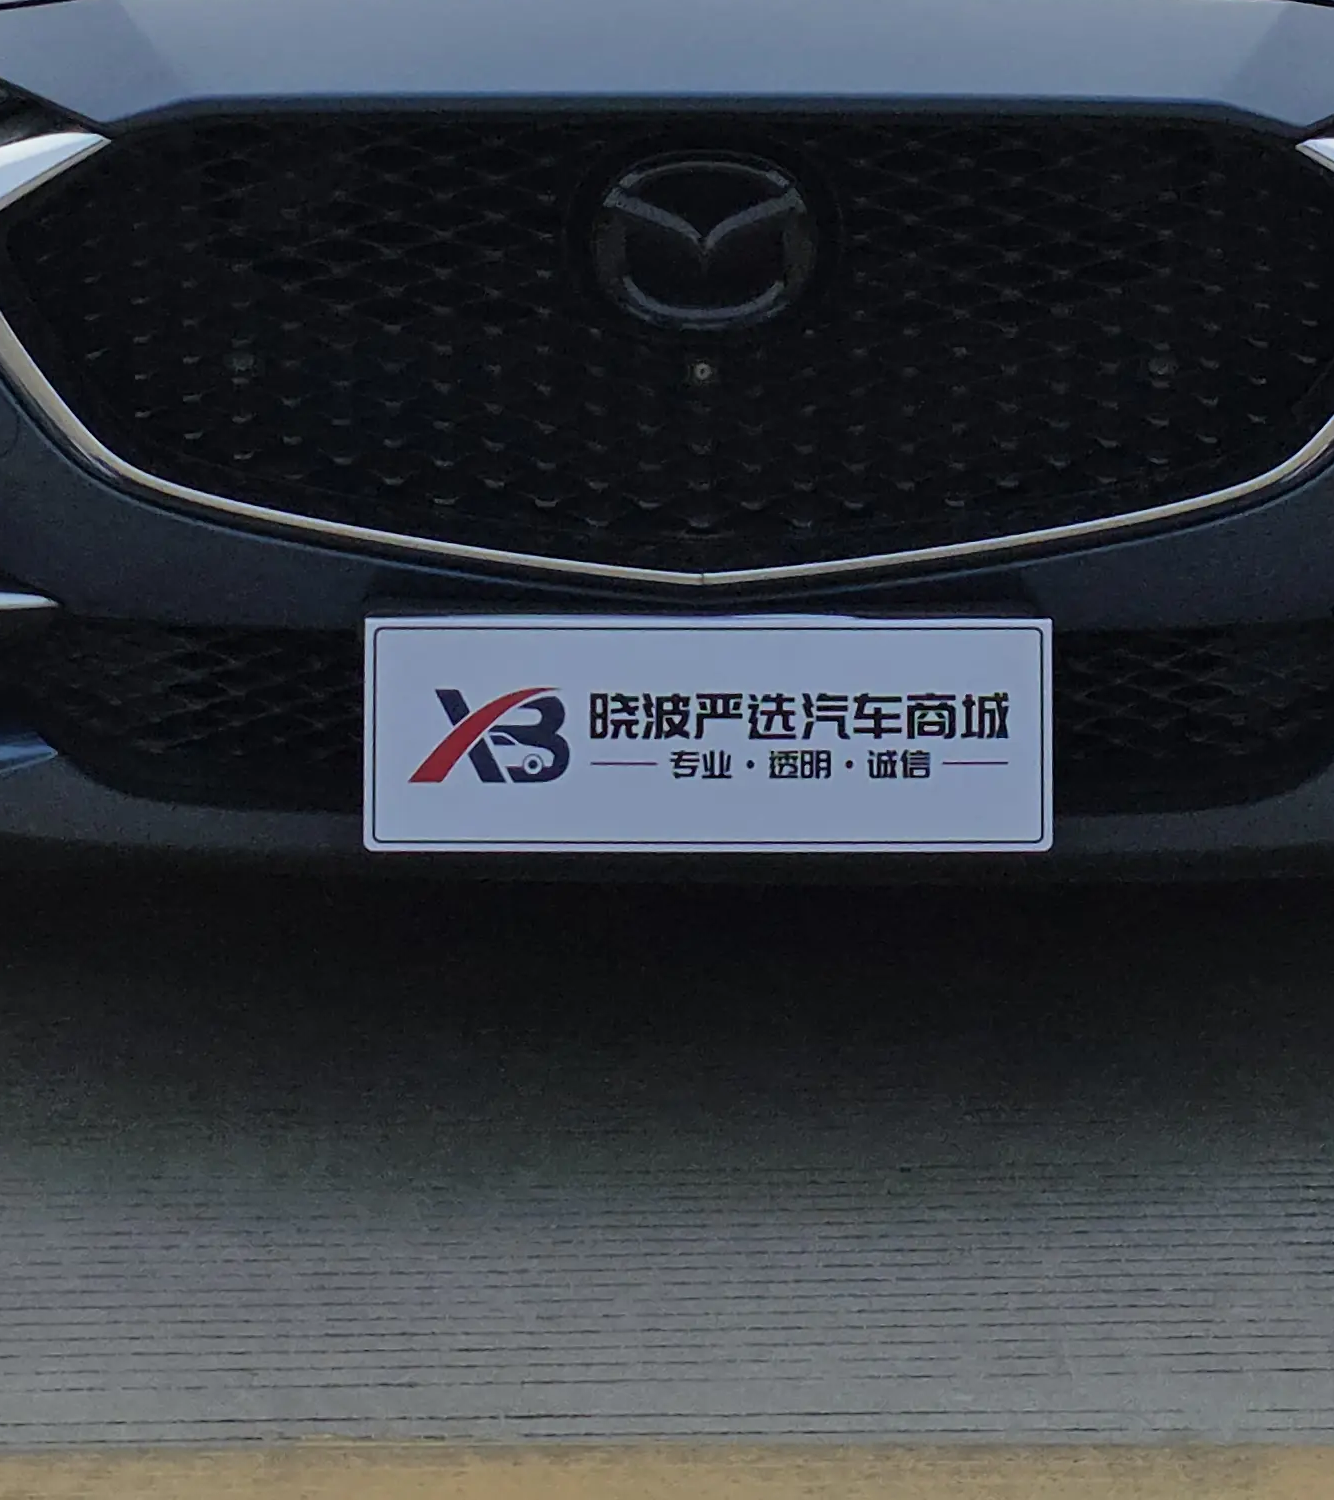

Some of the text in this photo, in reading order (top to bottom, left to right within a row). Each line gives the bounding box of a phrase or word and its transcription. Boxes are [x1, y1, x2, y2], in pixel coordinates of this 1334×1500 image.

[589, 693, 1010, 740] 晓波严选汽车商城
